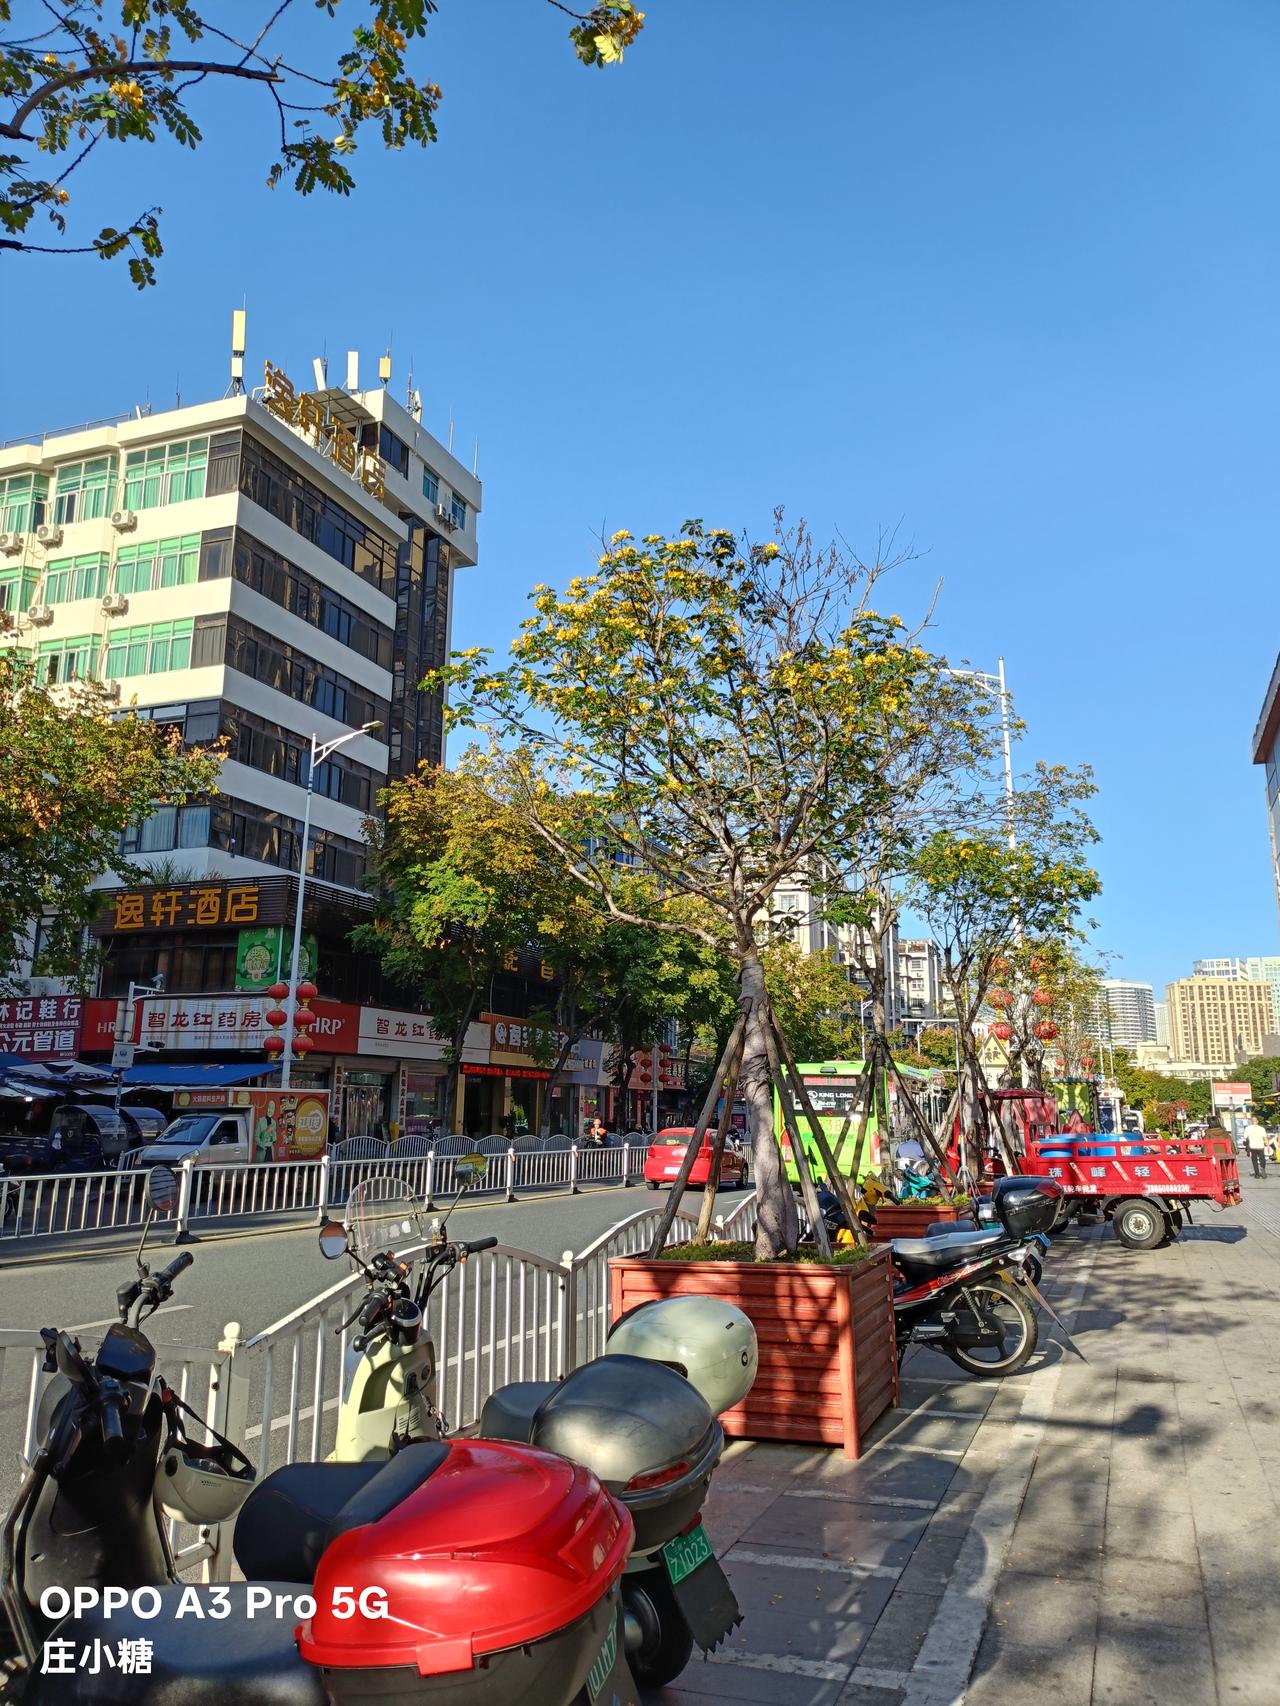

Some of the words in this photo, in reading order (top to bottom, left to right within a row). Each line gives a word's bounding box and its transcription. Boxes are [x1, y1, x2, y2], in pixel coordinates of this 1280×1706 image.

[114, 887, 259, 929] 逸轩酒店
[97, 1021, 116, 1033] HR
[148, 1011, 262, 1028] 智龙红药房
[308, 1016, 342, 1035] HRP
[376, 1017, 446, 1040] 智龙红
[1048, 1165, 1198, 1178] 珠峰轻卡
[669, 1535, 708, 1580] Z1023
